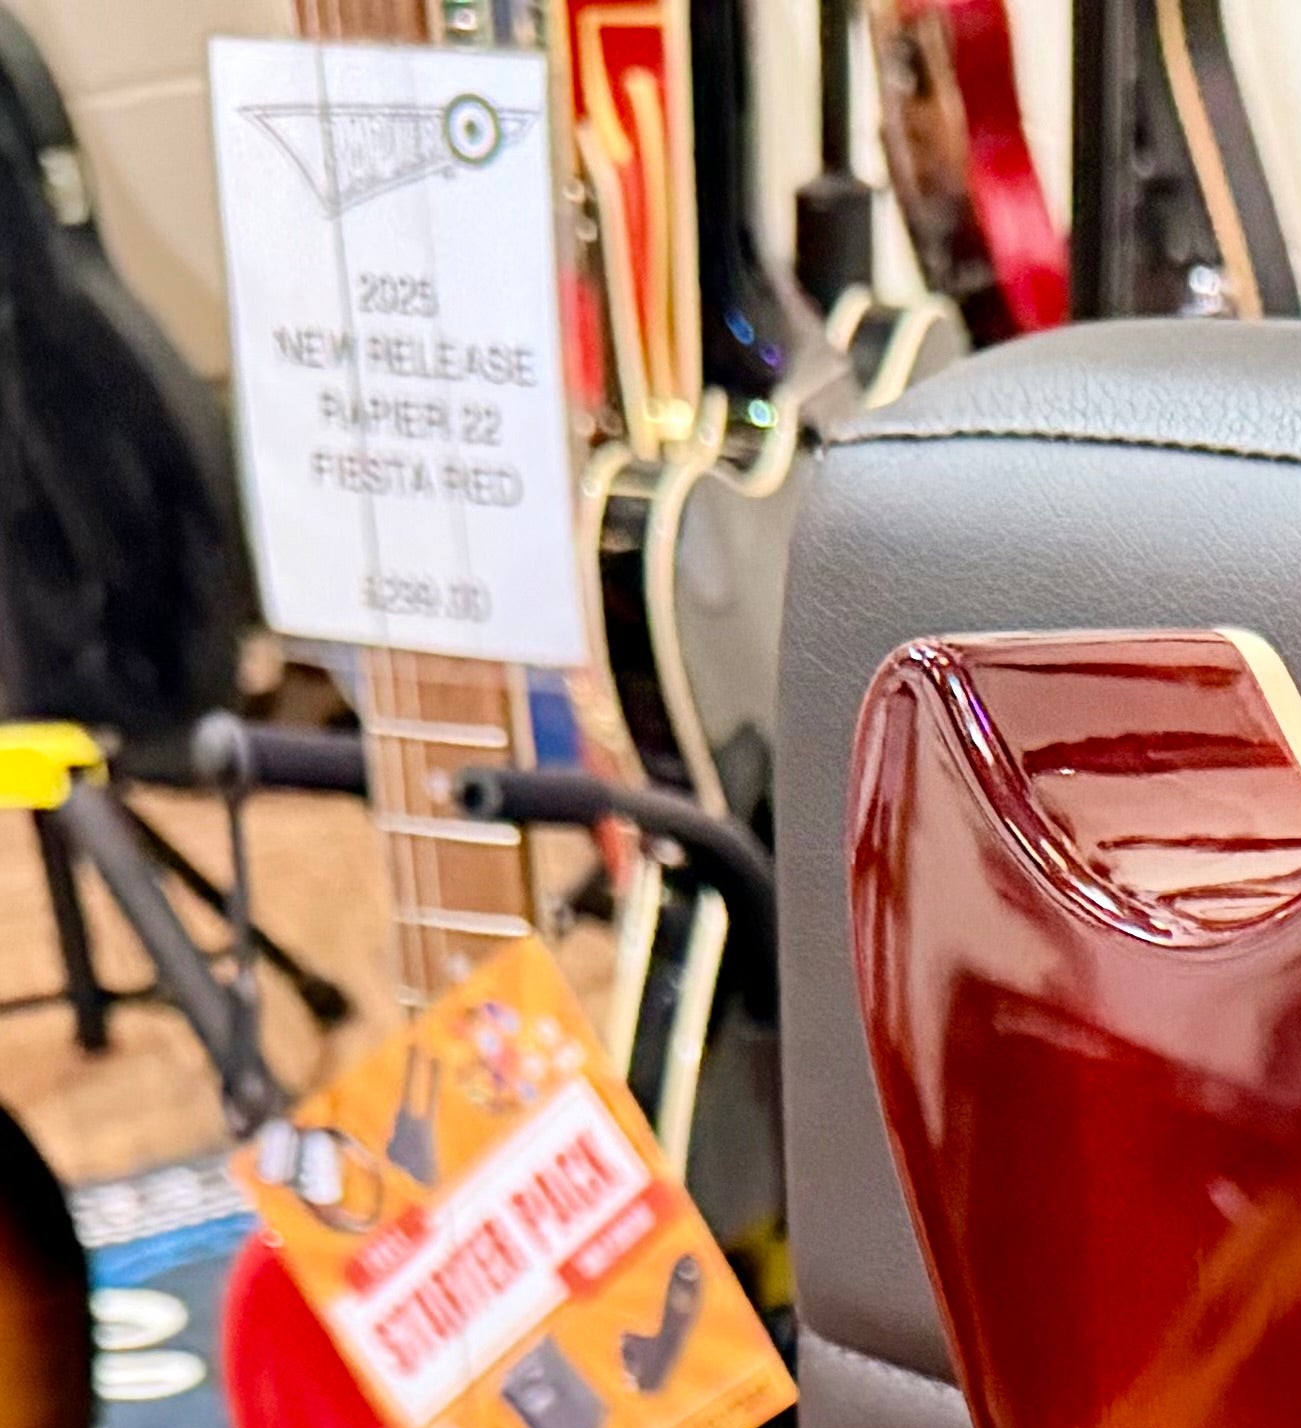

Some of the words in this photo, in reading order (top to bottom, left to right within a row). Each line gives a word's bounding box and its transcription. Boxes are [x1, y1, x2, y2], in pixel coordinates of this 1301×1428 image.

[358, 275, 440, 318] 2025
[273, 328, 356, 371] NEW
[366, 331, 539, 389] RELEASE
[461, 402, 501, 447] 22
[311, 451, 436, 499] FIESTA
[442, 460, 525, 509] RED
[373, 1217, 531, 1378] STARTER
[510, 1127, 618, 1258] PACK
